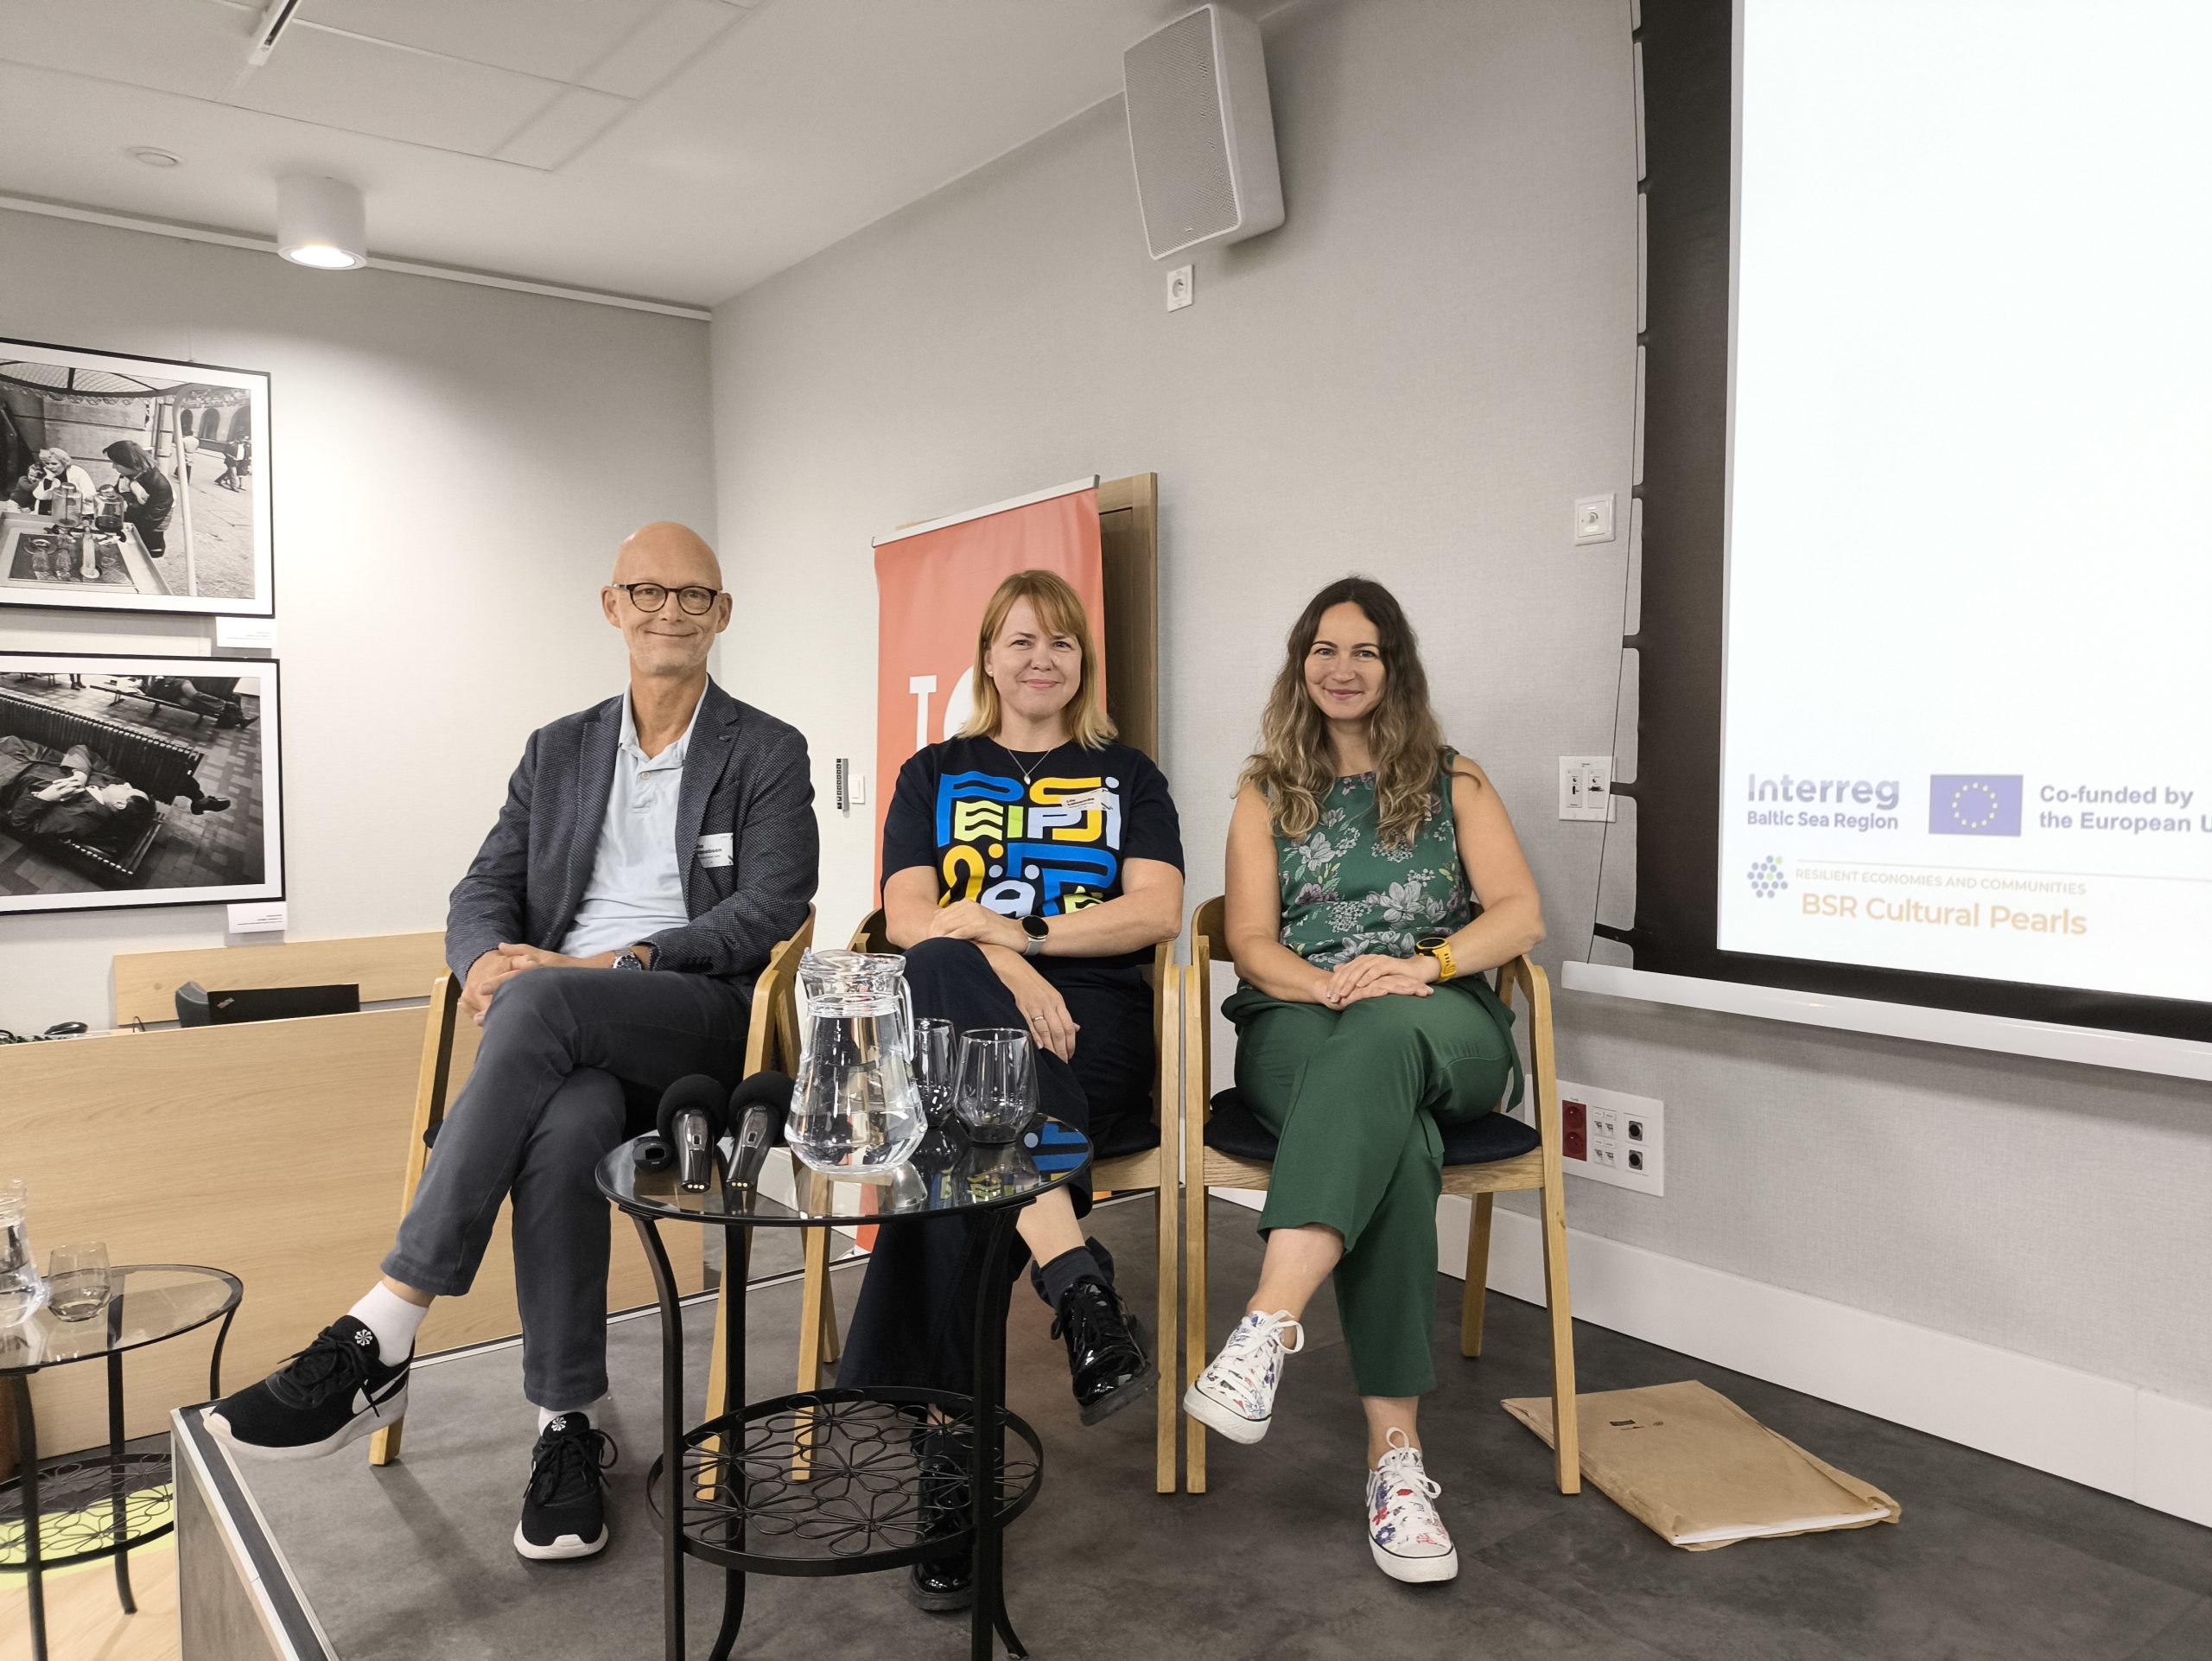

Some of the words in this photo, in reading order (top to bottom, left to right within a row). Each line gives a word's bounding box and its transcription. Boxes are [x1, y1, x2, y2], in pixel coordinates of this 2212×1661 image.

[1748, 773, 1900, 811] Interreg
[2040, 784, 2158, 805] Co-funded
[2164, 786, 2195, 810] by
[1747, 810, 1795, 826] Baltic
[1797, 811, 1830, 827] Sea
[1834, 812, 1899, 832] Region
[2039, 811, 2074, 830] the
[2079, 811, 2191, 835] European
[1795, 868, 1859, 882] RESILIENT
[1861, 871, 1943, 888] ECONOMIES
[1945, 875, 1978, 889] AND
[1980, 878, 2088, 896] COMMUNITIES
[1802, 893, 1858, 919] BSR
[1866, 897, 1980, 927] Cultural
[1990, 904, 2088, 935] Pearls
